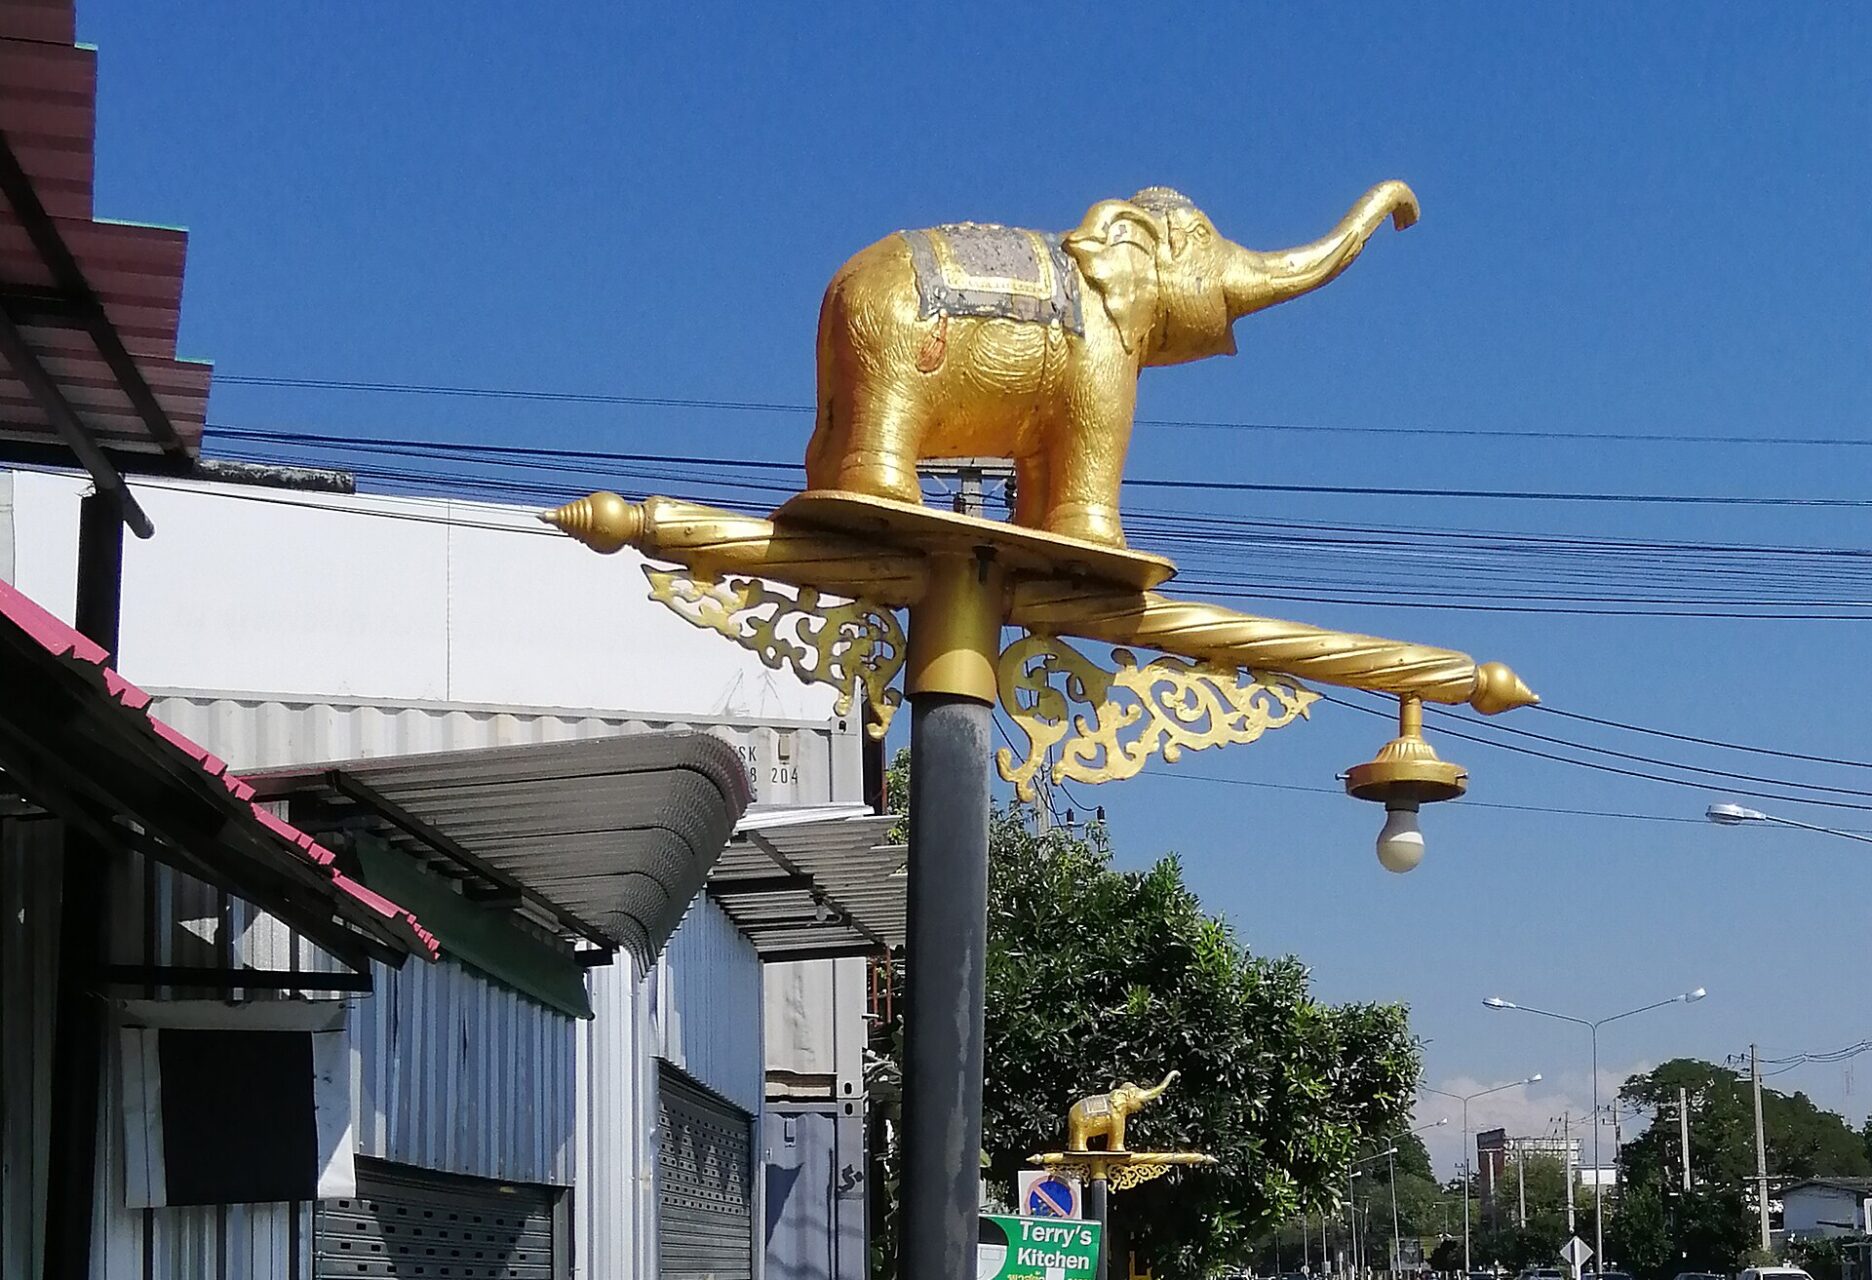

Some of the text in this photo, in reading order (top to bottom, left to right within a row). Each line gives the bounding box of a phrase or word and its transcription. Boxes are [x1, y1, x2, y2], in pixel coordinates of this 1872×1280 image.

[734, 745, 757, 761] SK
[1019, 1221, 1092, 1248] Terry's
[1017, 1247, 1090, 1270] Kitchen
